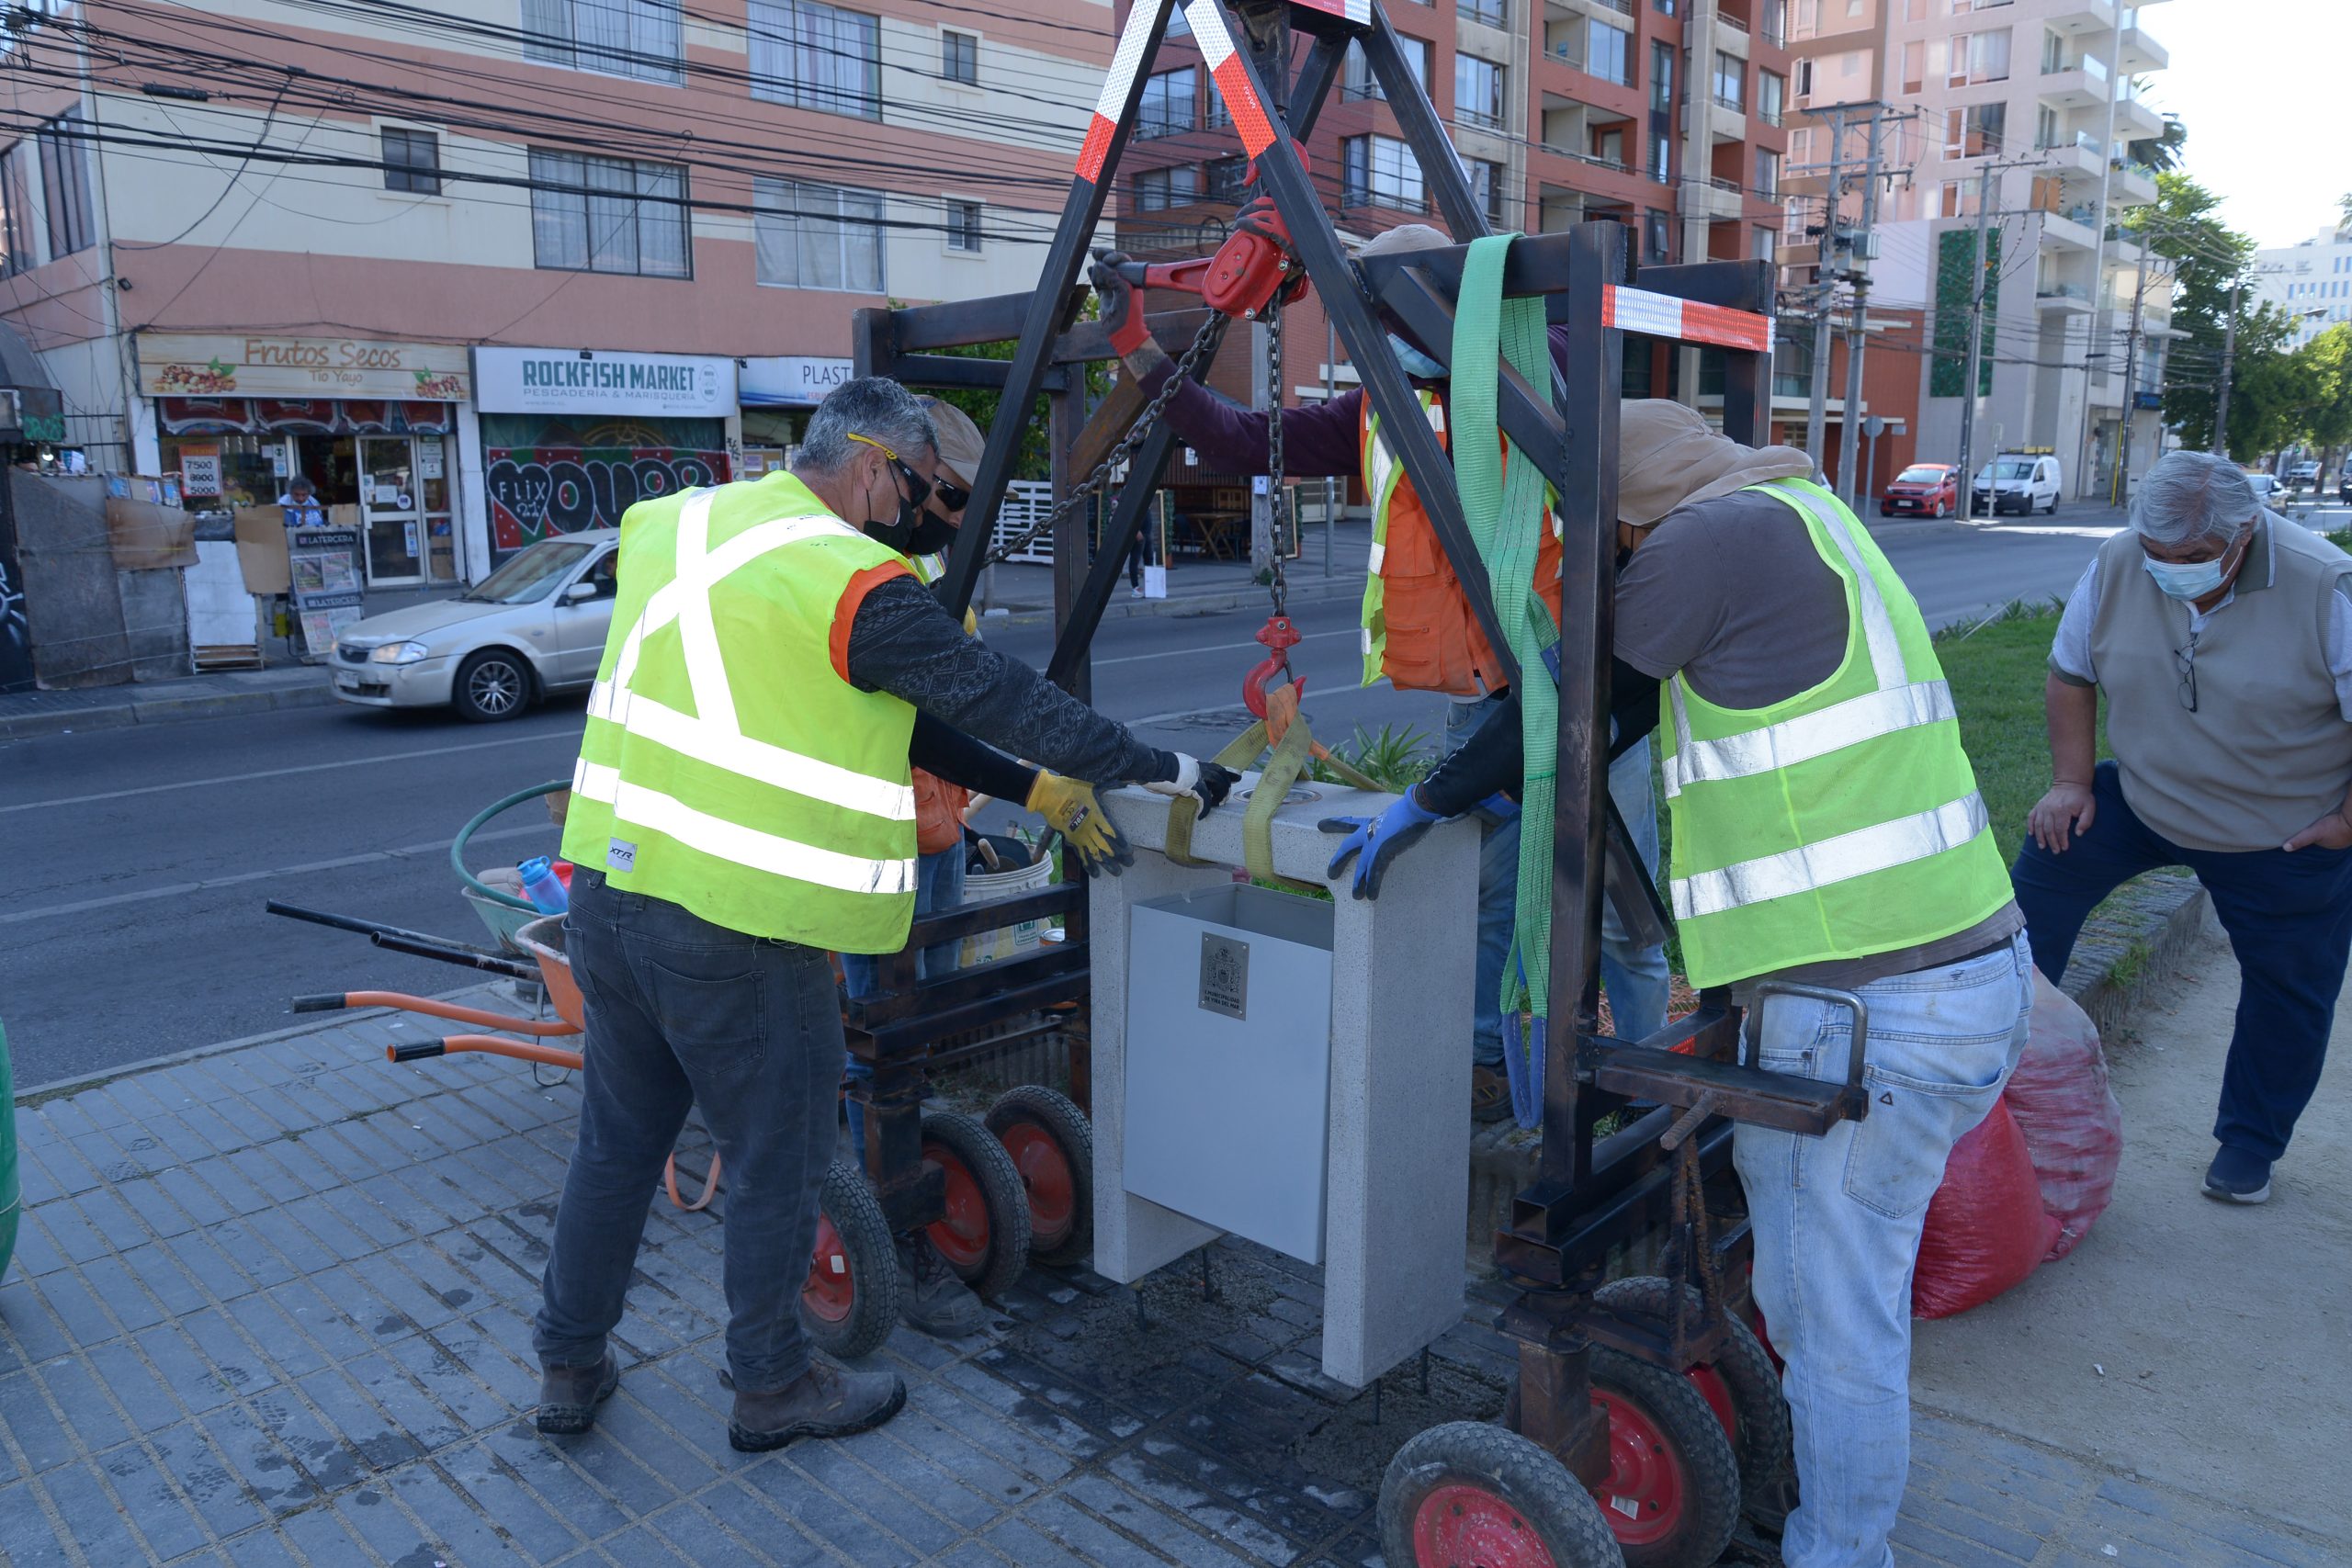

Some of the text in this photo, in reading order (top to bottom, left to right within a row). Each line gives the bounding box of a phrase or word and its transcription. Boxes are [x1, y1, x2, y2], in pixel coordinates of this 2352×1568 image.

[244, 339, 401, 367] Frutos Secos
[334, 370, 363, 387] Yayo
[523, 360, 695, 390] ROCKFISH MARKET
[523, 388, 608, 398] PESCADERÍA
[612, 389, 620, 398] &
[625, 391, 696, 400] MARISQUERÍA
[186, 460, 212, 469] 7500
[190, 486, 216, 494] 5000
[610, 846, 633, 859] XTR
